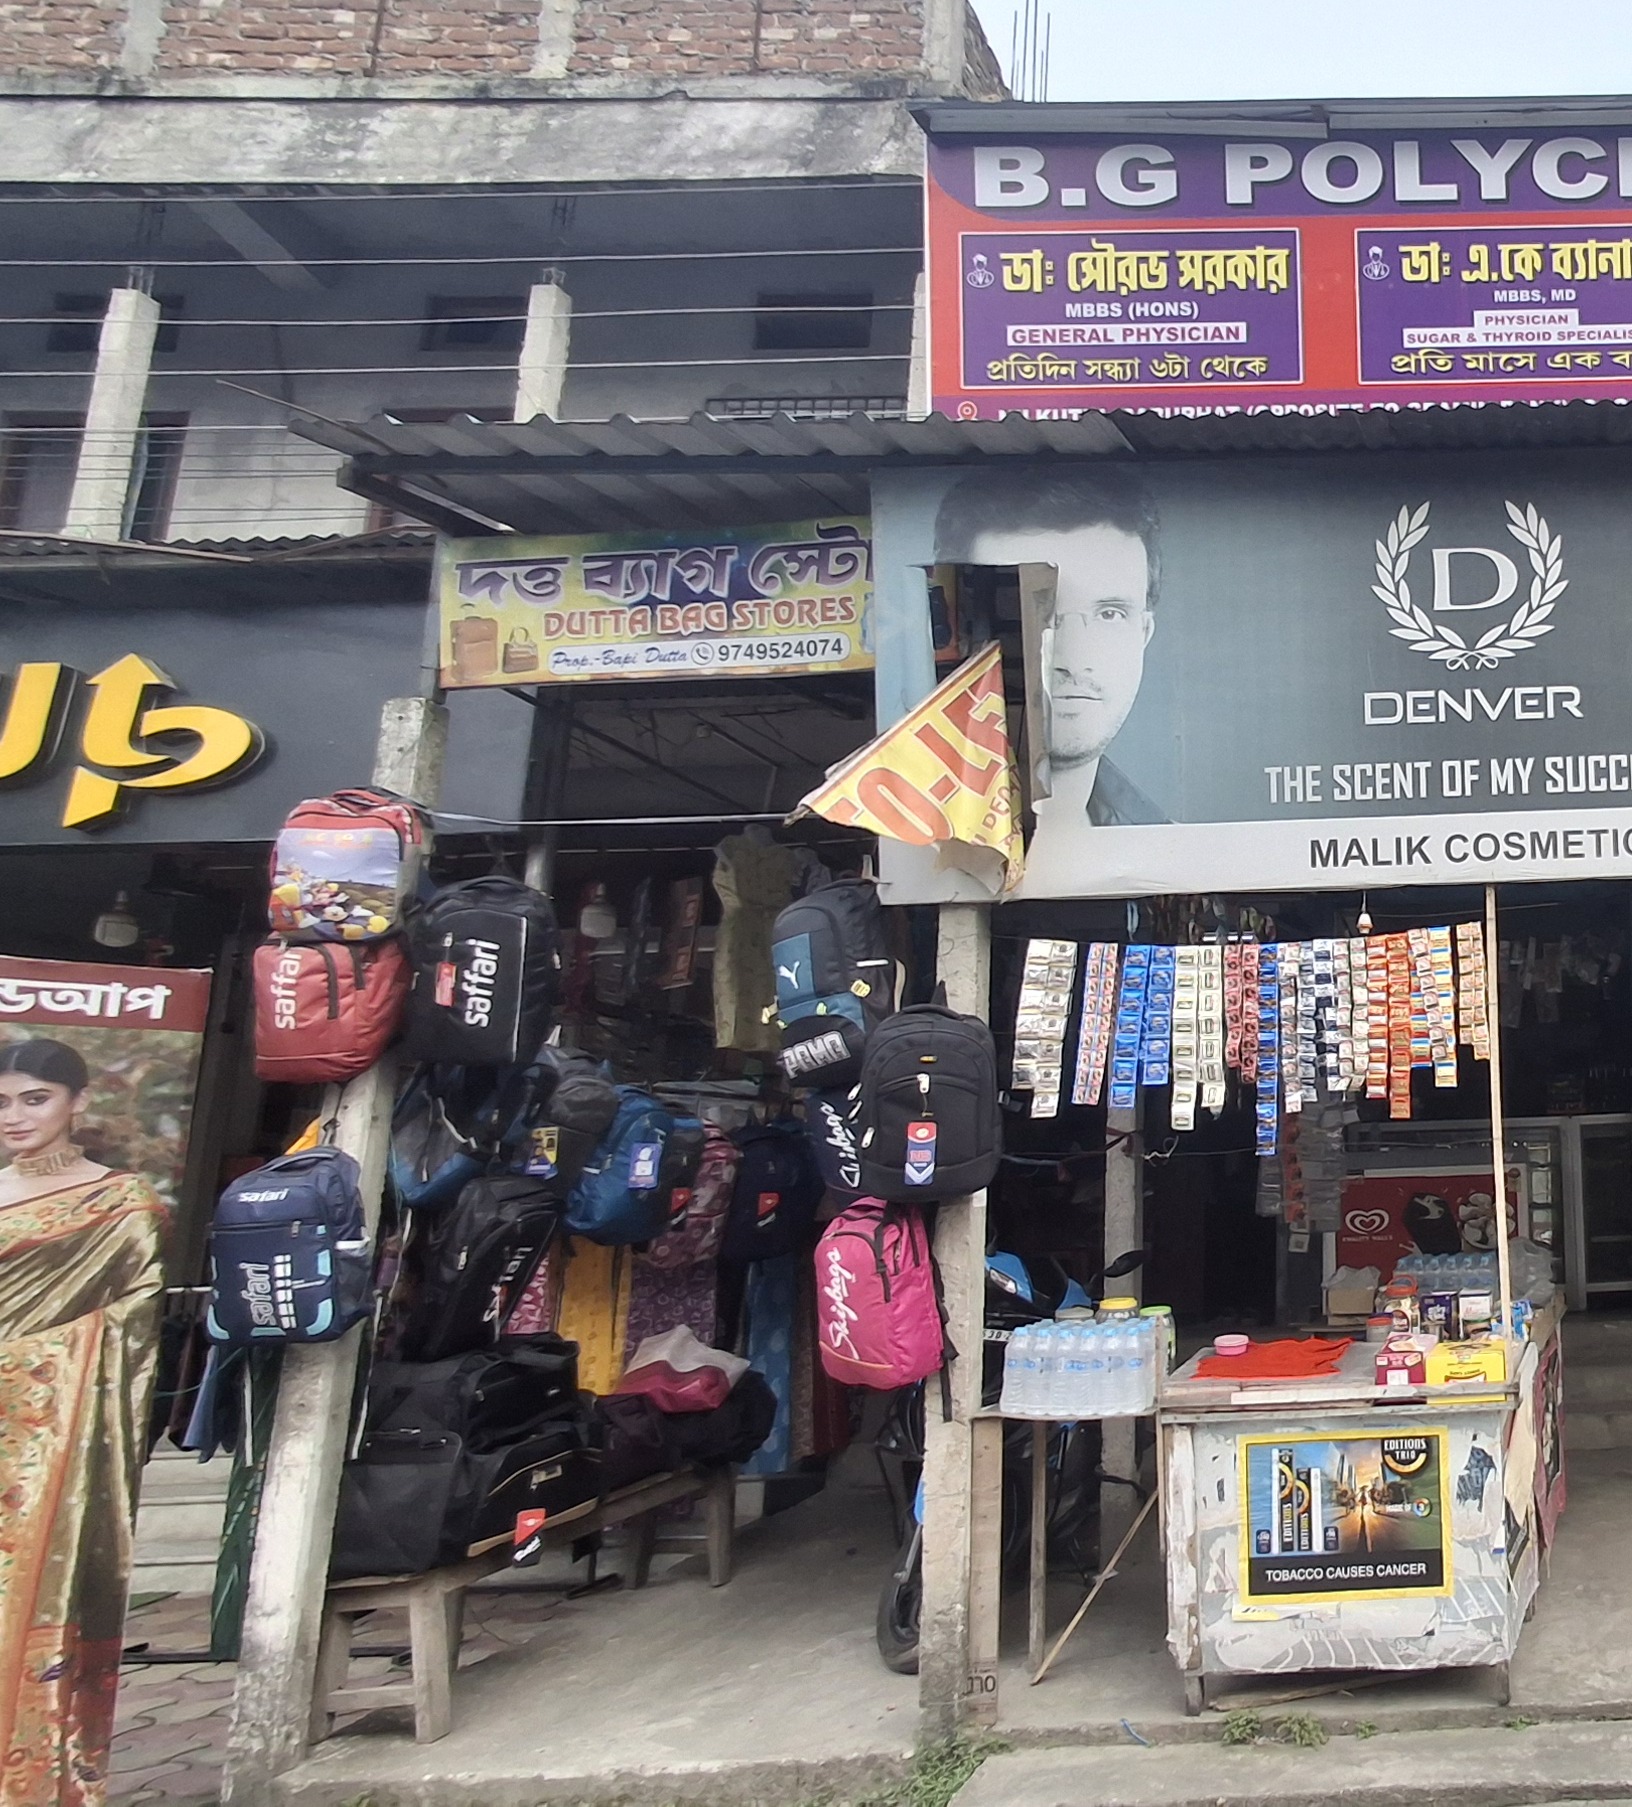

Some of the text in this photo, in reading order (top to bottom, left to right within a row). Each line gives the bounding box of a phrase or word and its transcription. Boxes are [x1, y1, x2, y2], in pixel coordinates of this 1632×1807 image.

[974, 144, 1179, 207] B.G
[1067, 239, 1169, 298] সৌরভ
[1177, 246, 1290, 296] সরকার
[1461, 243, 1544, 283] এ.কে
[1065, 300, 1199, 321] MBBS (HONS)
[1494, 289, 1577, 304] MBBS, MD
[1484, 314, 1569, 326] PHYSICIAN
[1011, 325, 1241, 345] GENERAL PHYSICIAN
[1407, 332, 1461, 345] SUGAR
[1466, 332, 1477, 344] &
[1482, 330, 1552, 343] THYROID
[986, 352, 1269, 382] প্রতিদিন সন্ধ্যা ৬টা থেকে
[1391, 348, 1455, 375] প্রতি
[1462, 352, 1537, 372] মাসে
[1547, 350, 1602, 371] এক
[455, 522, 874, 606] দত্ত ব্যাগ স্টো
[1432, 547, 1518, 611] D
[543, 596, 856, 639] DUTTA BAG STORES
[645, 647, 687, 666] Dutta
[717, 638, 844, 664] 9749524074
[1364, 685, 1584, 725] DENVER
[1265, 764, 1322, 804] THE
[1333, 760, 1432, 801] SCENT
[1442, 759, 1480, 797] OF
[1490, 756, 1535, 796] MY
[1310, 836, 1432, 868] MALIK
[462, 938, 501, 1029] saffari
[239, 1187, 289, 1205] safari
[239, 1261, 277, 1327] safari
[1384, 1438, 1427, 1451] EDITIONS
[1395, 1450, 1416, 1460] TRIO
[1265, 1562, 1428, 1583] TOBACCO CAUSES CANCER
